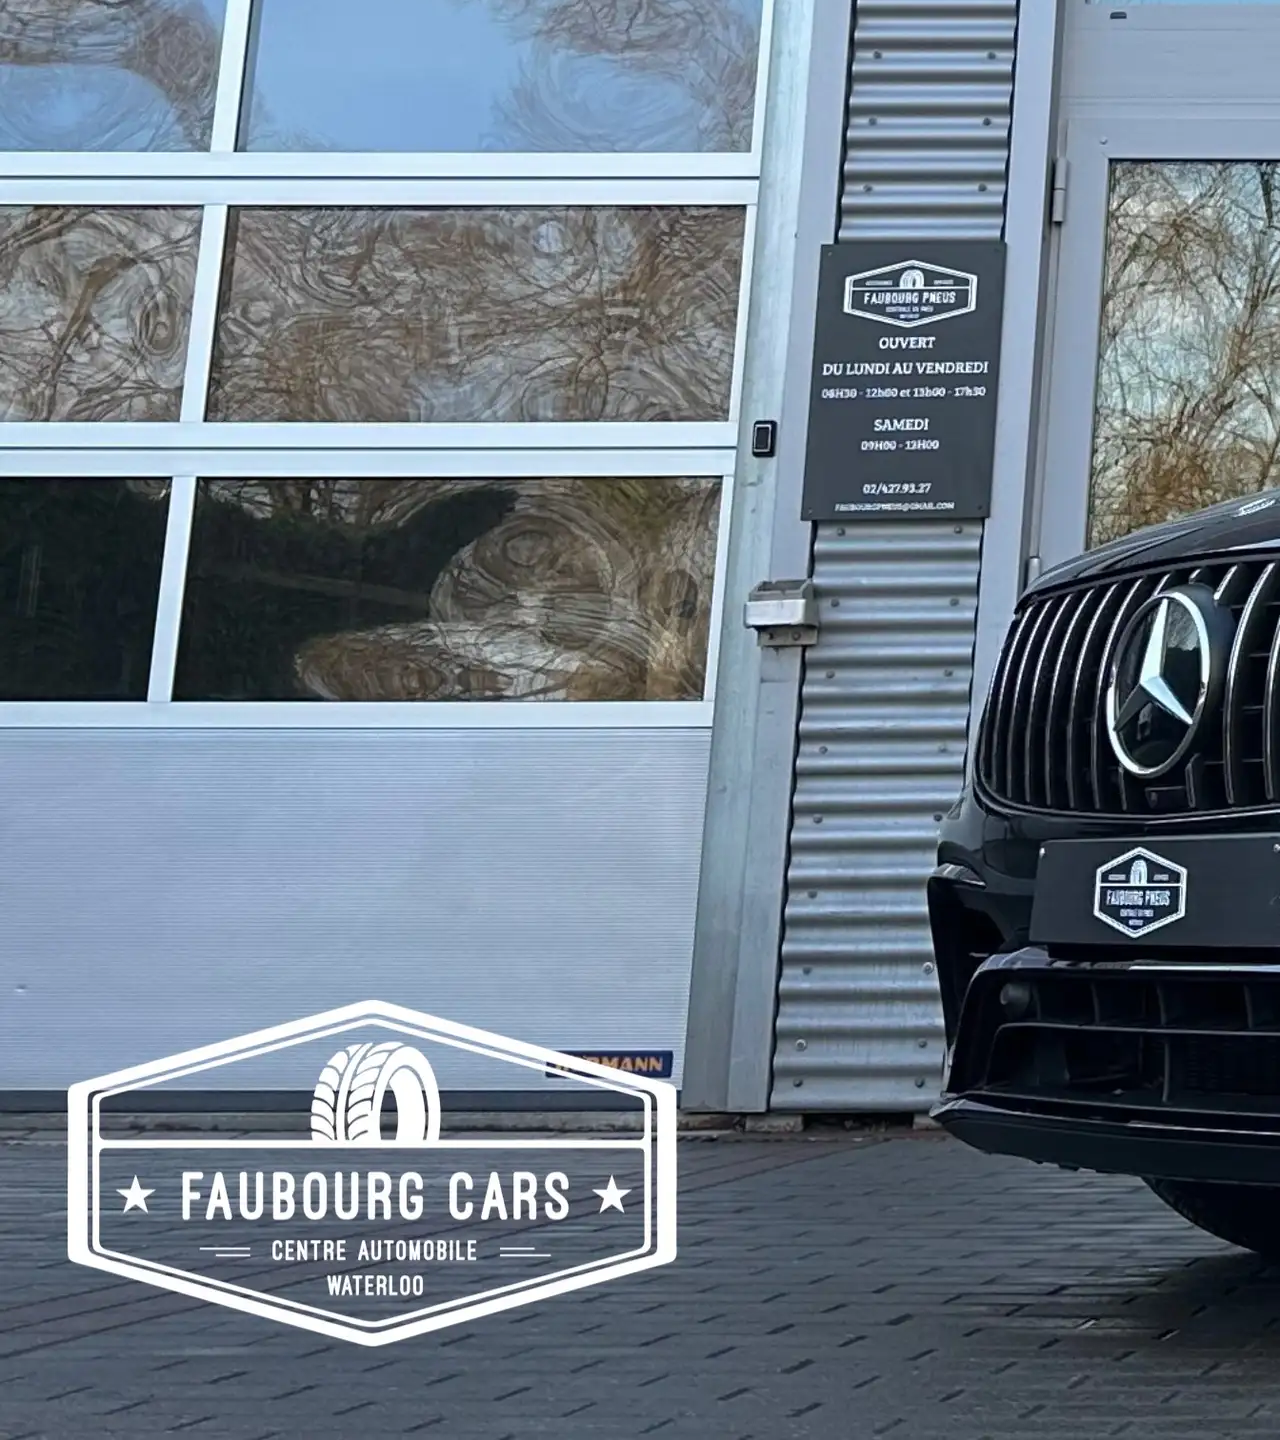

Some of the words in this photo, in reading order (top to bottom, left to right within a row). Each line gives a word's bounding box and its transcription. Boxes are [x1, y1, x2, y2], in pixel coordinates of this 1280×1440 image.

[863, 292, 919, 305] FAUBOURG
[922, 291, 957, 304] PNEUS
[878, 336, 936, 349] OUVERT
[822, 363, 843, 375] DU
[845, 362, 891, 375] LUNDI
[892, 362, 914, 375] AU
[915, 361, 989, 375] VENDREDI
[899, 388, 911, 398] et
[873, 417, 931, 432] SAMEDI
